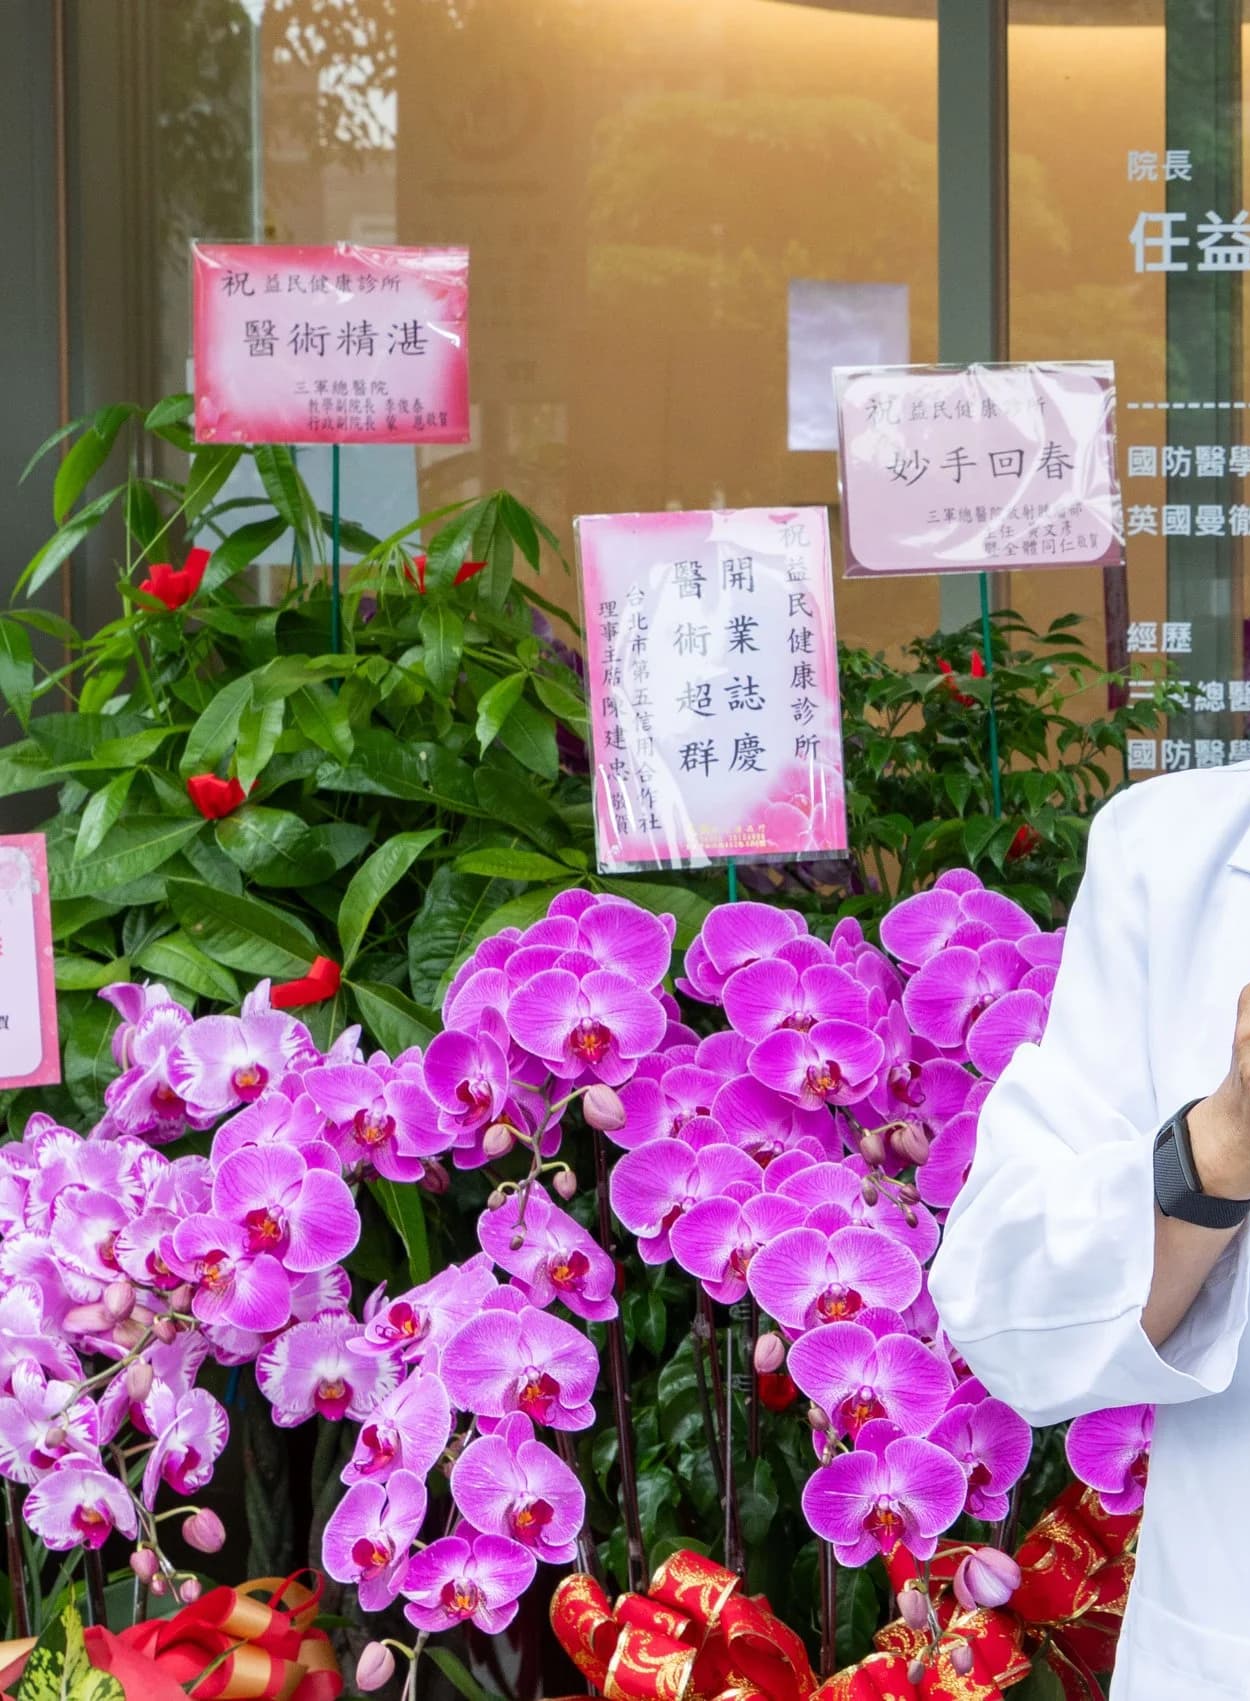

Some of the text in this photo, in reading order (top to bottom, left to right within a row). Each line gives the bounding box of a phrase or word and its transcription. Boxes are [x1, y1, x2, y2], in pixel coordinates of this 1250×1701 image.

[1127, 149, 1193, 182] 院長
[222, 270, 402, 297] 祝 益民健康診所
[243, 319, 428, 357] 醫術精湛
[887, 441, 1075, 488] 妙手回春
[1127, 622, 1192, 653] 經歷
[672, 559, 720, 777] 醫術超群
[721, 556, 768, 773] 開業誌慶
